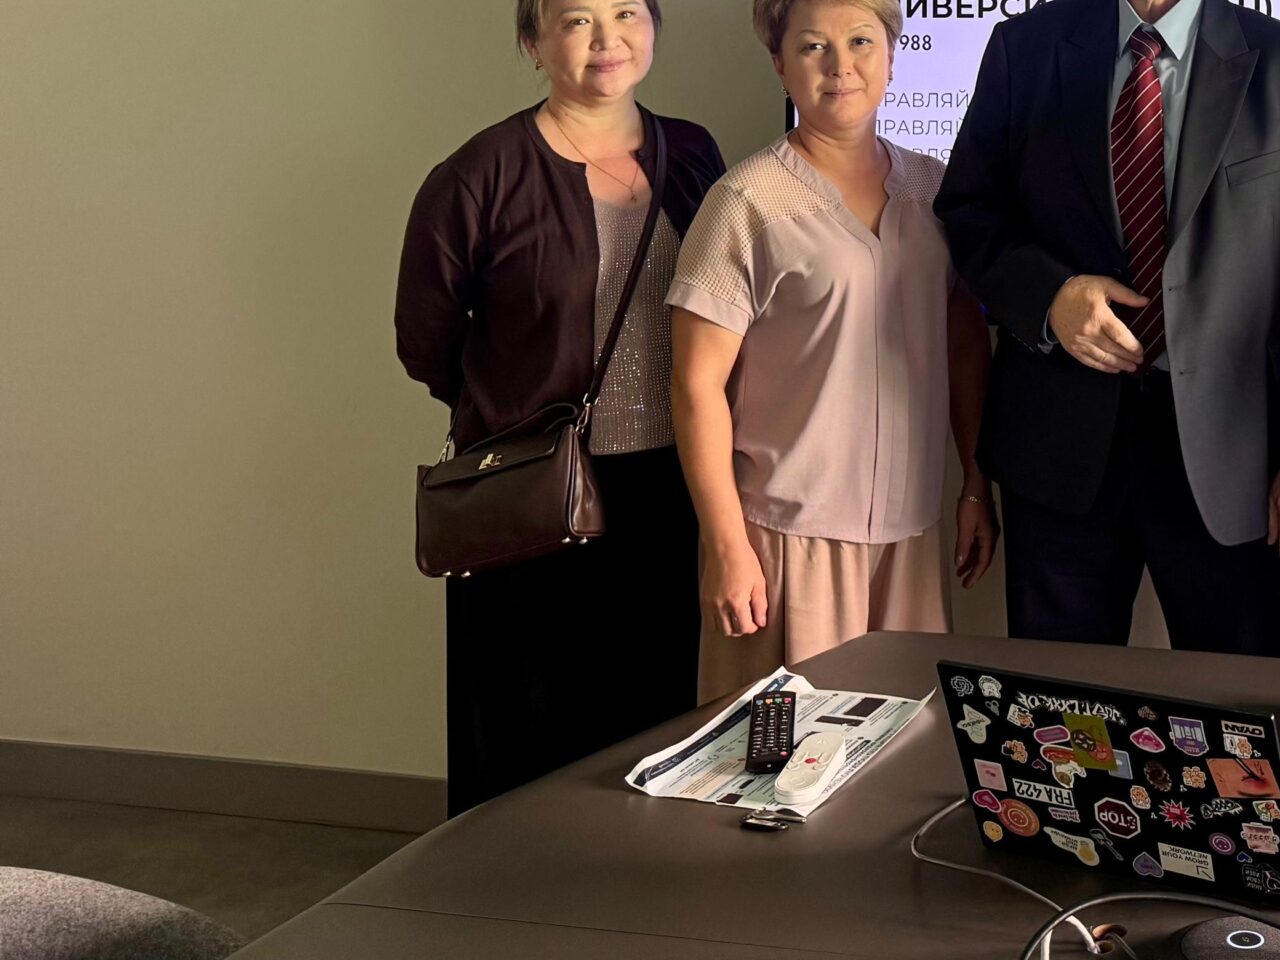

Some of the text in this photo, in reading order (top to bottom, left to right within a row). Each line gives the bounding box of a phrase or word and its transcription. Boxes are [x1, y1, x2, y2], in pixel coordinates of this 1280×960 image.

[899, 34, 932, 51] 988
[884, 88, 969, 108] РАВЛЯЙ
[1015, 780, 1073, 806] FRA 422
[1099, 809, 1137, 829] STOP
[1161, 849, 1209, 866] GROW YOUR
